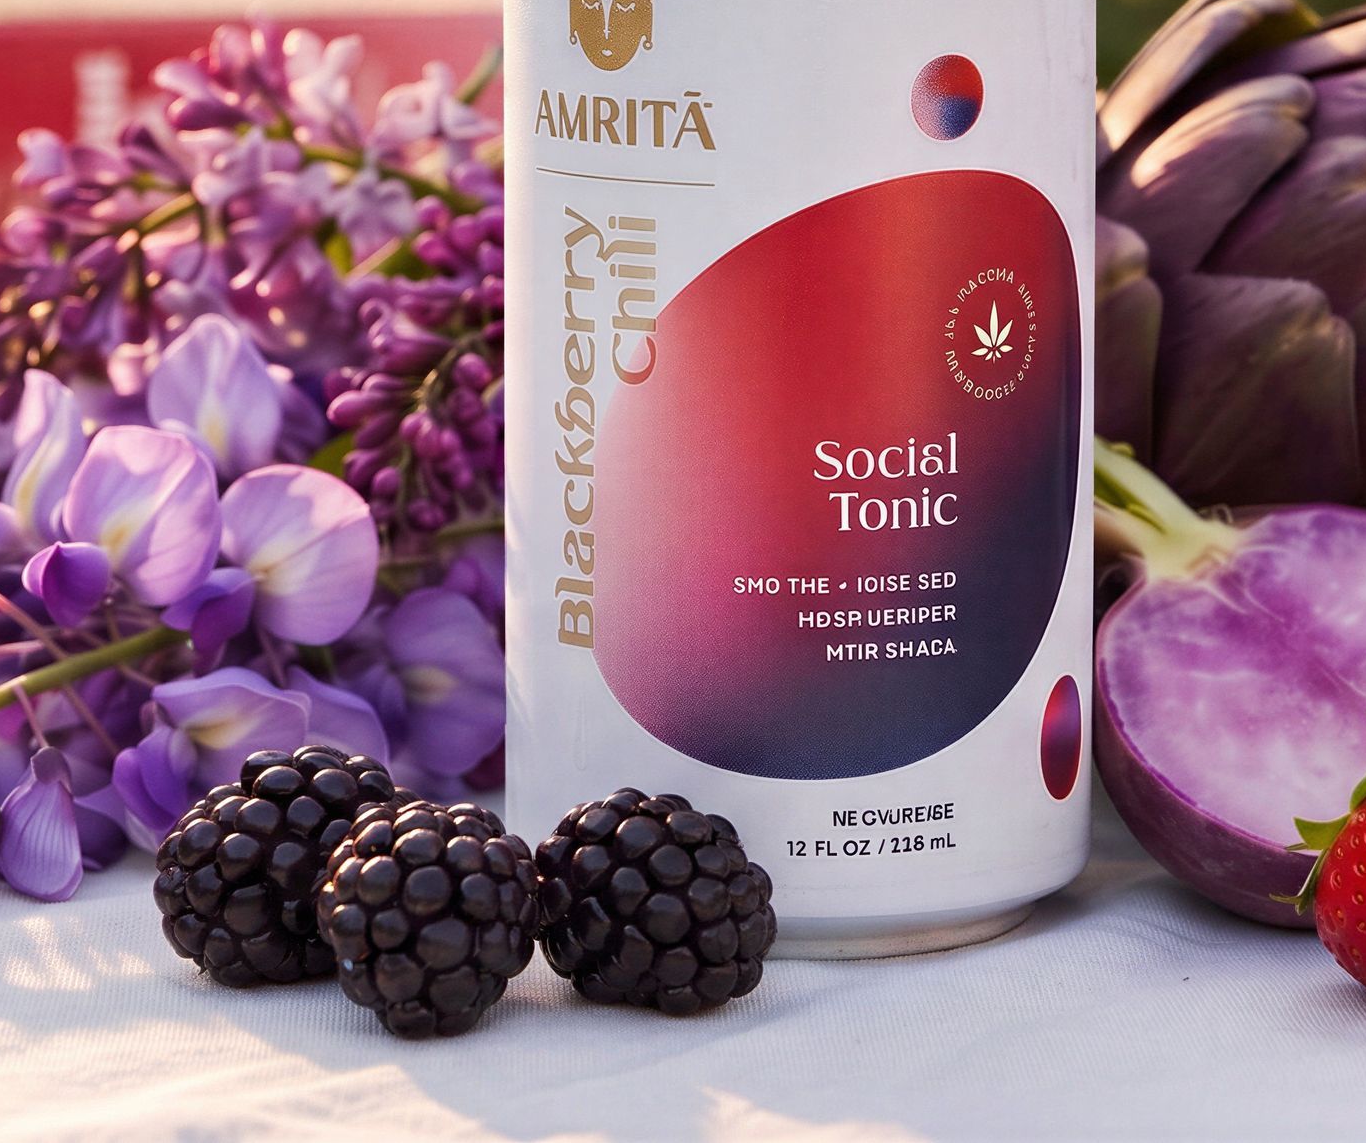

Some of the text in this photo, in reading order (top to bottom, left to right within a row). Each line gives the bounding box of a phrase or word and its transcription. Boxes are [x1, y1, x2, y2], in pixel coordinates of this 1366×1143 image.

[555, 205, 606, 649] Blackberry
[813, 431, 959, 481] Social
[829, 487, 959, 531] Tonic
[733, 576, 780, 594] SMO
[787, 577, 830, 594] THE
[918, 571, 957, 590] SED
[787, 840, 806, 856] 12
[815, 840, 837, 856] FL
[843, 840, 870, 856] OZ
[930, 833, 956, 850] mL
